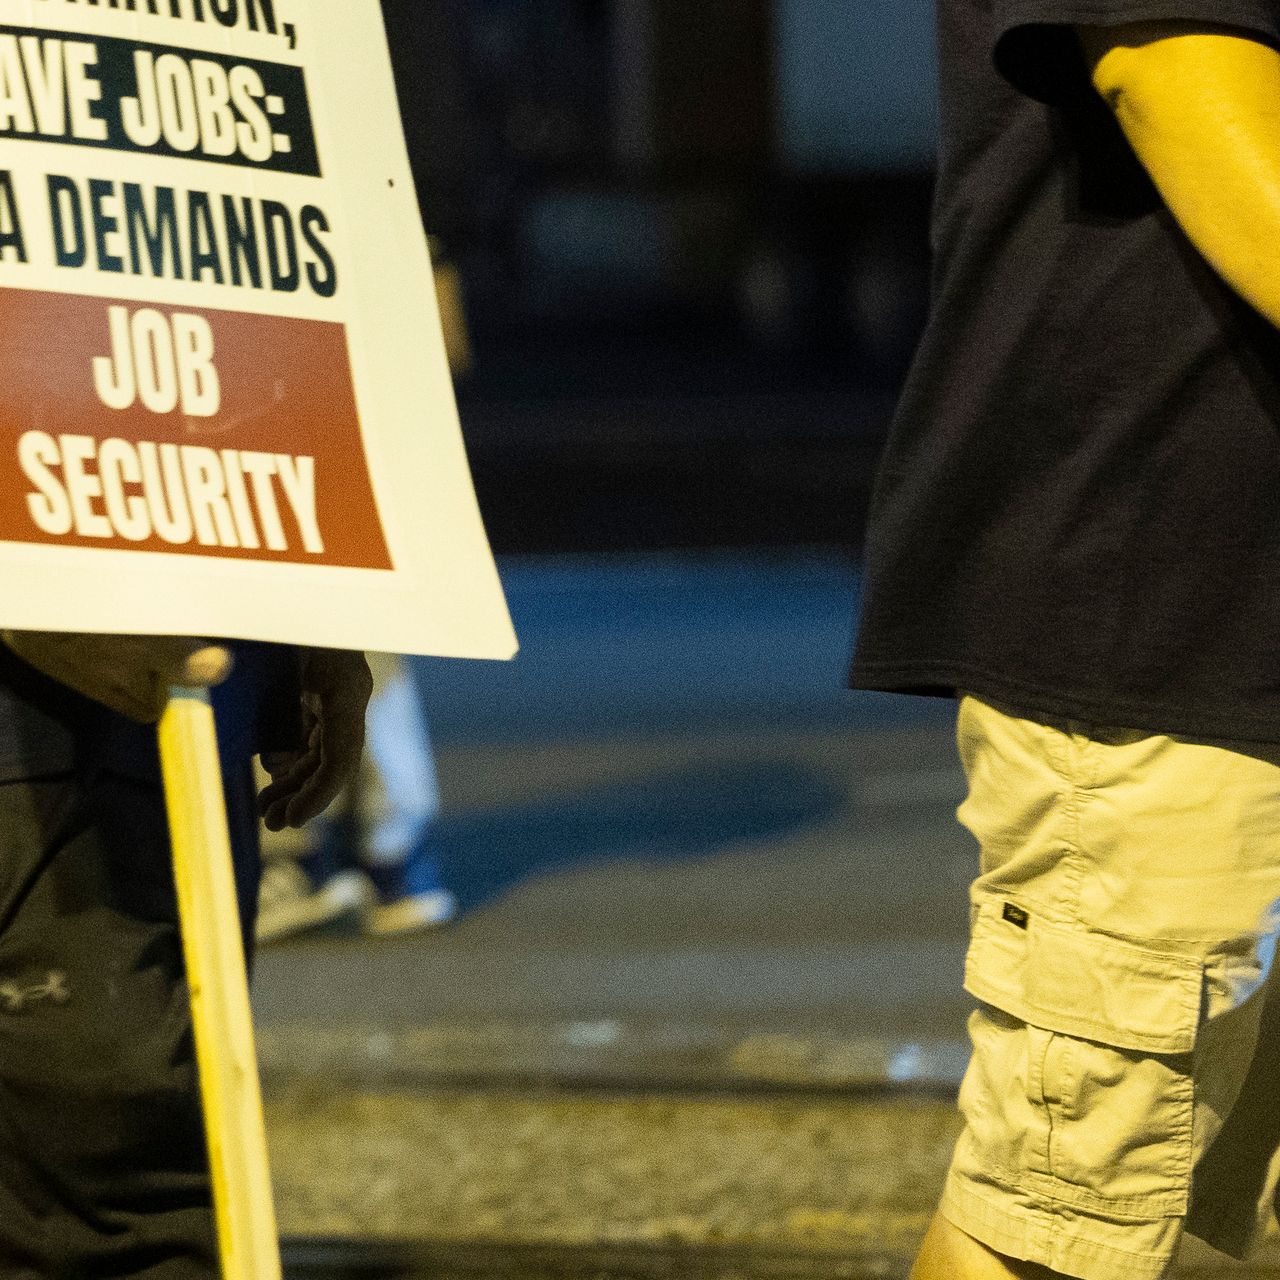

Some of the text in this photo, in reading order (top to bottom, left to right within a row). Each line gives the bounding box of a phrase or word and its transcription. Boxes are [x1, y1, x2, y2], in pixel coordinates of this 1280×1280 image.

[120, 50, 291, 162] JOBS:
[46, 174, 337, 298] DEMANDS
[91, 305, 220, 417] JOB
[17, 429, 317, 554] SECURITY
